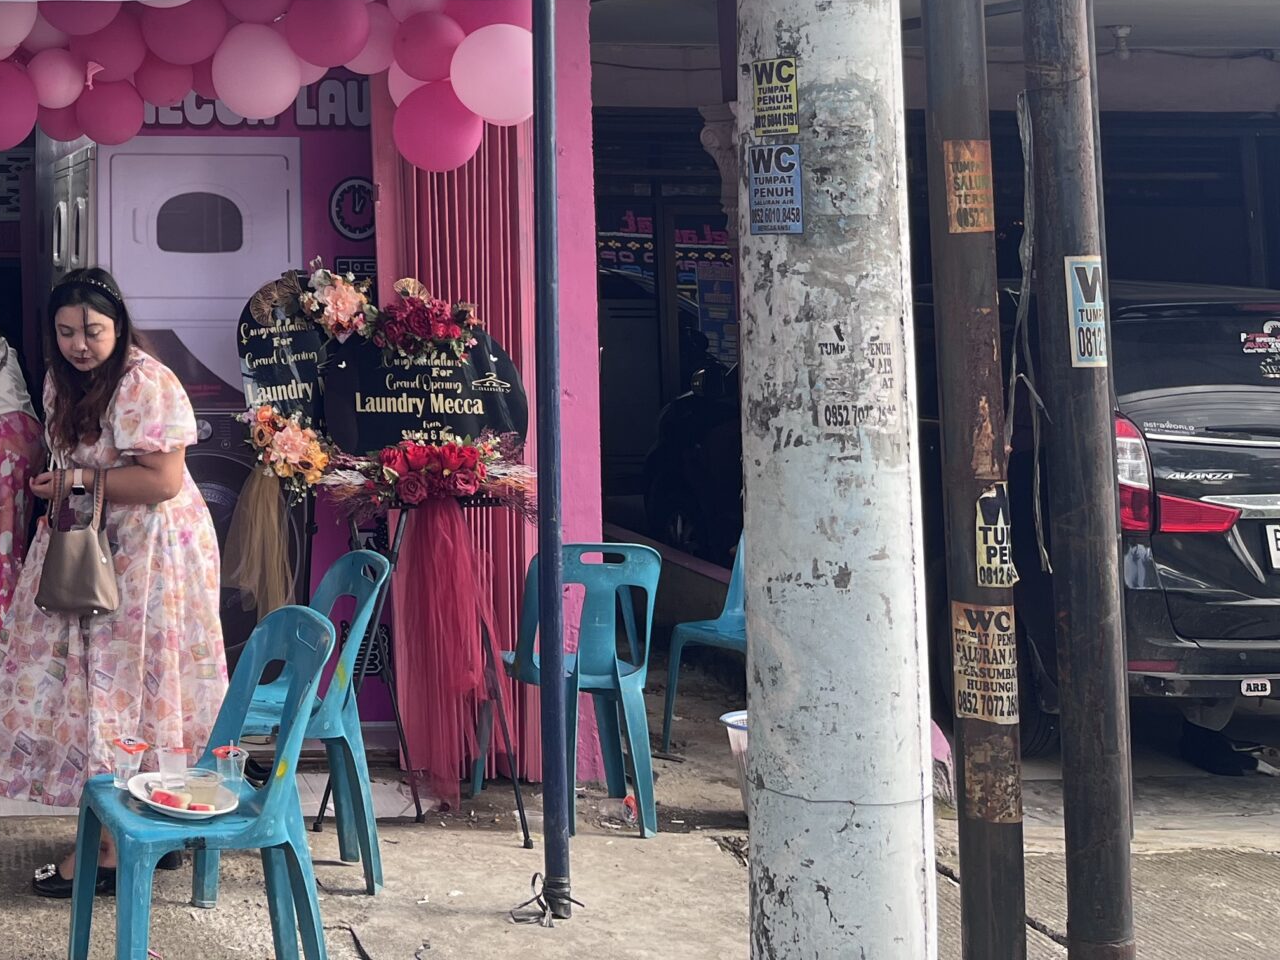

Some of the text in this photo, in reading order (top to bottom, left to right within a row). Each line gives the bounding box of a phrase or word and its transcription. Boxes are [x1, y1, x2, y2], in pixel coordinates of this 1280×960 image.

[754, 60, 795, 86] WC
[758, 85, 790, 95] TUMPAT
[757, 94, 792, 106] PENUH
[750, 146, 796, 174] WC
[754, 175, 793, 186] TUMPAT
[754, 187, 794, 198] PENUH
[272, 337, 293, 347] For
[868, 343, 891, 356] ENUH
[431, 367, 453, 377] For
[246, 380, 314, 404] Laundry
[355, 392, 485, 418] Laundry Mecca
[1168, 471, 1234, 480] AVANZA
[964, 609, 1011, 633] WC
[958, 665, 1017, 680] ERSUMBA
[1246, 683, 1268, 692] ARB
[981, 695, 1005, 717] 7072
